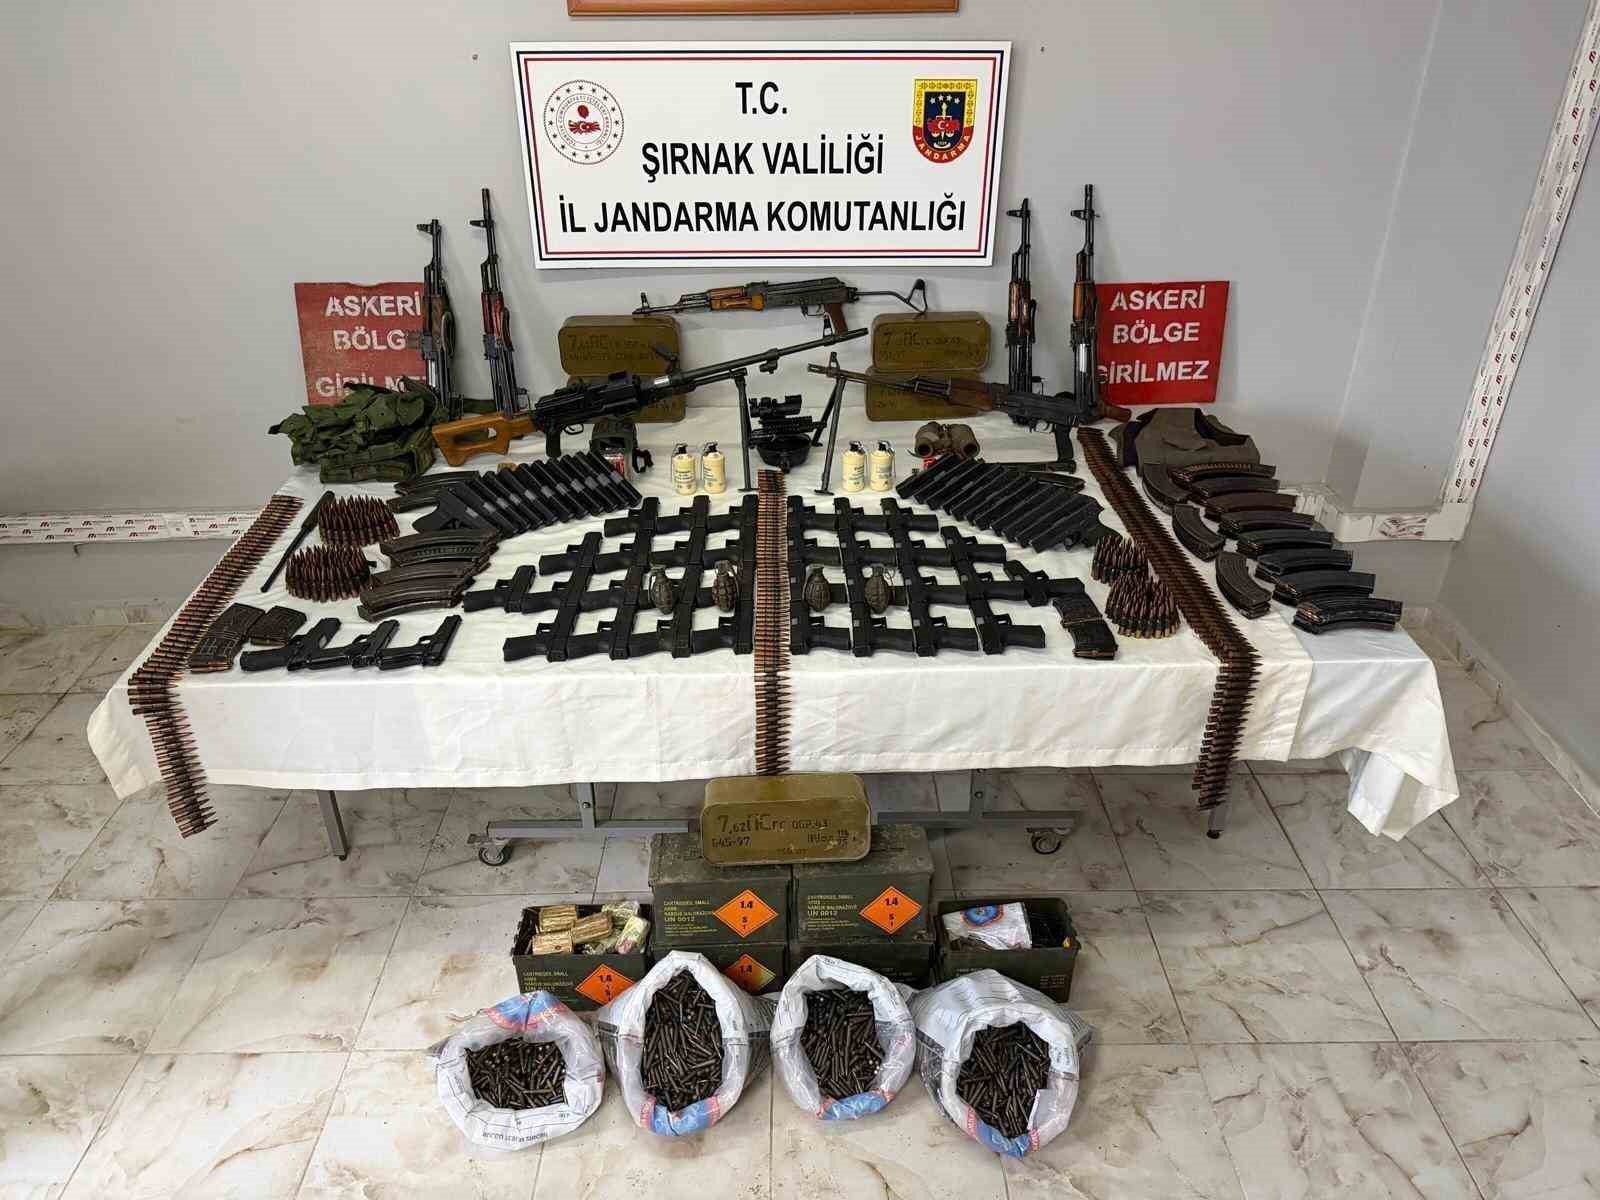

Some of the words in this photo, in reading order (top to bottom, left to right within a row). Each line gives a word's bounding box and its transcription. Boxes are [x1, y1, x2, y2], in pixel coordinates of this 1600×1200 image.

[735, 81, 787, 115] T.C.
[641, 142, 755, 183] ŞIRNAK
[763, 133, 884, 175] VALİLİĞİ
[915, 135, 970, 160] JANDARMA
[559, 194, 586, 233] İL
[594, 202, 758, 233] JANDARMA
[766, 192, 966, 232] KOMUTANLIĞI
[325, 291, 421, 317] ASKERİ
[1110, 284, 1206, 312] ASKERİ
[333, 325, 406, 350] BÖLG
[1112, 319, 1200, 345] BÖLGE
[740, 900, 754, 909] 1.4
[885, 897, 899, 906] 1.4
[599, 974, 612, 983] 1.4
[740, 963, 753, 974] 1.4
